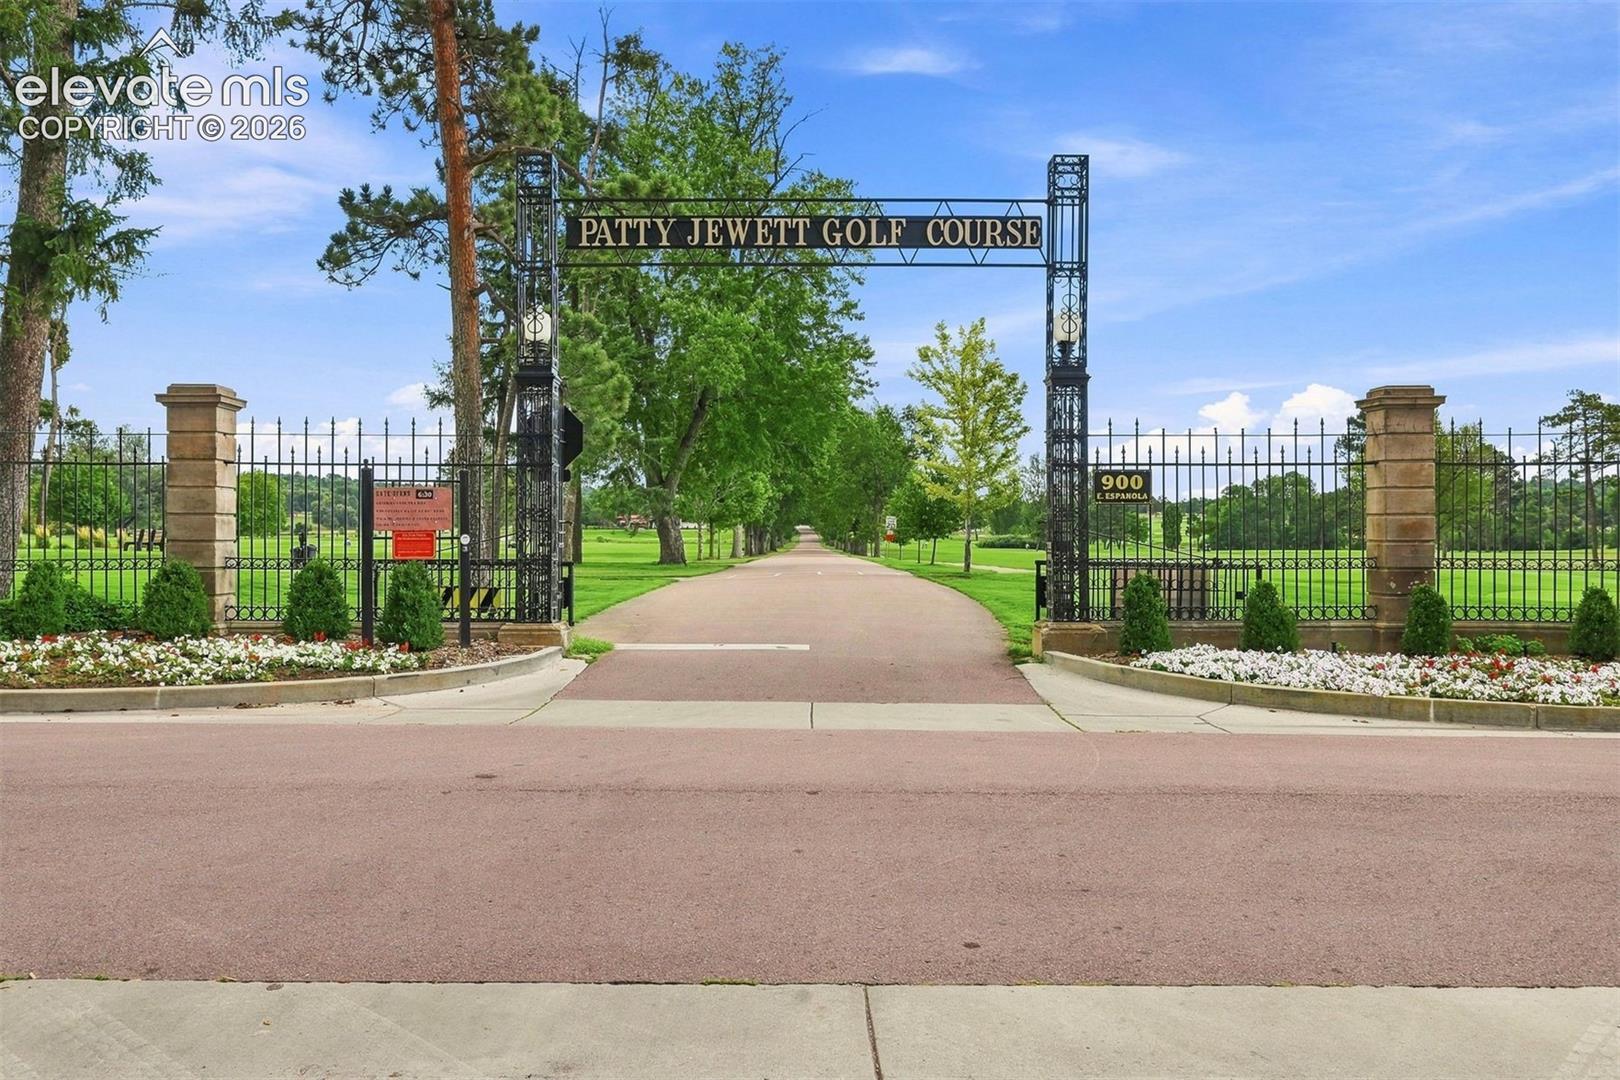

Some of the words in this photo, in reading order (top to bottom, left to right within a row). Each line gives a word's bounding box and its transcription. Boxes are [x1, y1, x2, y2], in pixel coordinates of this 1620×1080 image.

[578, 217, 677, 247] PATTY
[686, 217, 810, 247] JEWETT
[822, 217, 907, 246] GOLF
[926, 218, 1041, 247] COURSE
[1101, 474, 1143, 490] 900
